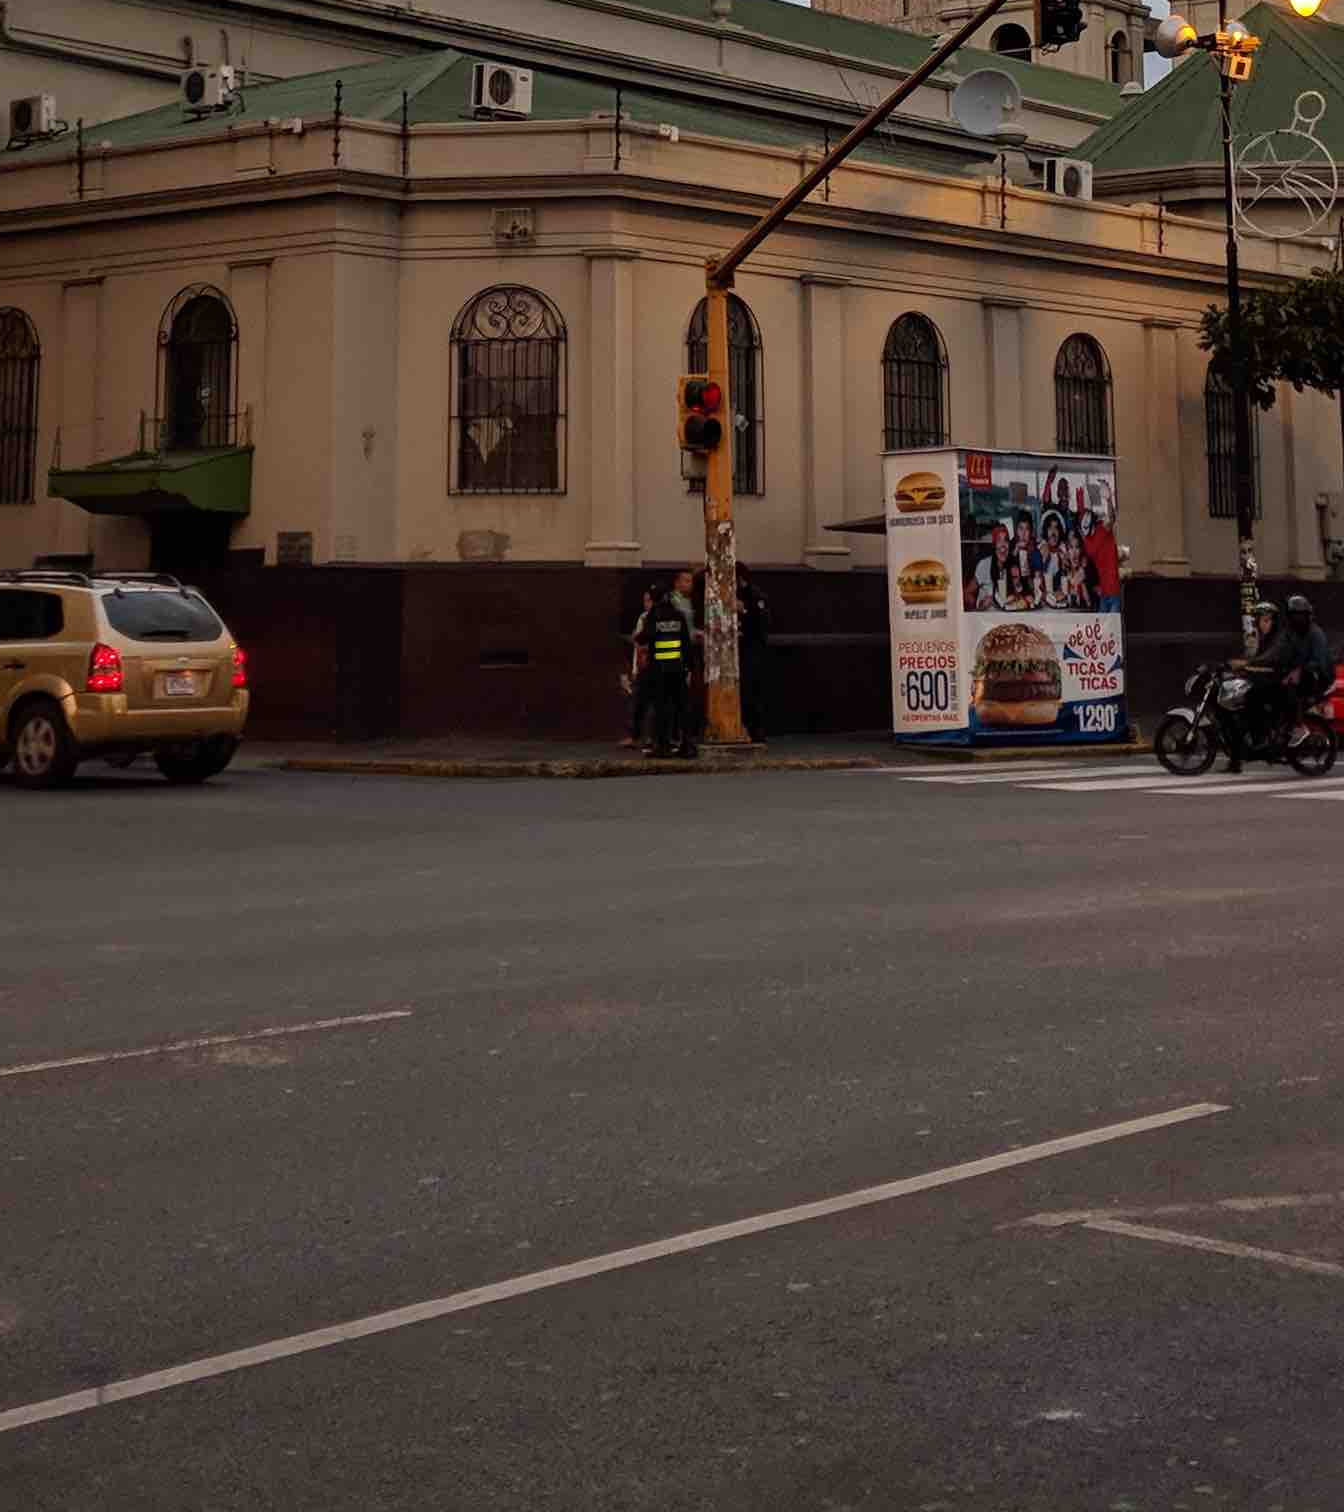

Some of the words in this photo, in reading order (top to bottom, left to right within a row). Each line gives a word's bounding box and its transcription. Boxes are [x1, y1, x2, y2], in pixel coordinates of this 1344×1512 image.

[899, 656, 957, 669] PRECIOS
[1067, 663, 1106, 676] TICAS
[1079, 677, 1118, 691] TICAS
